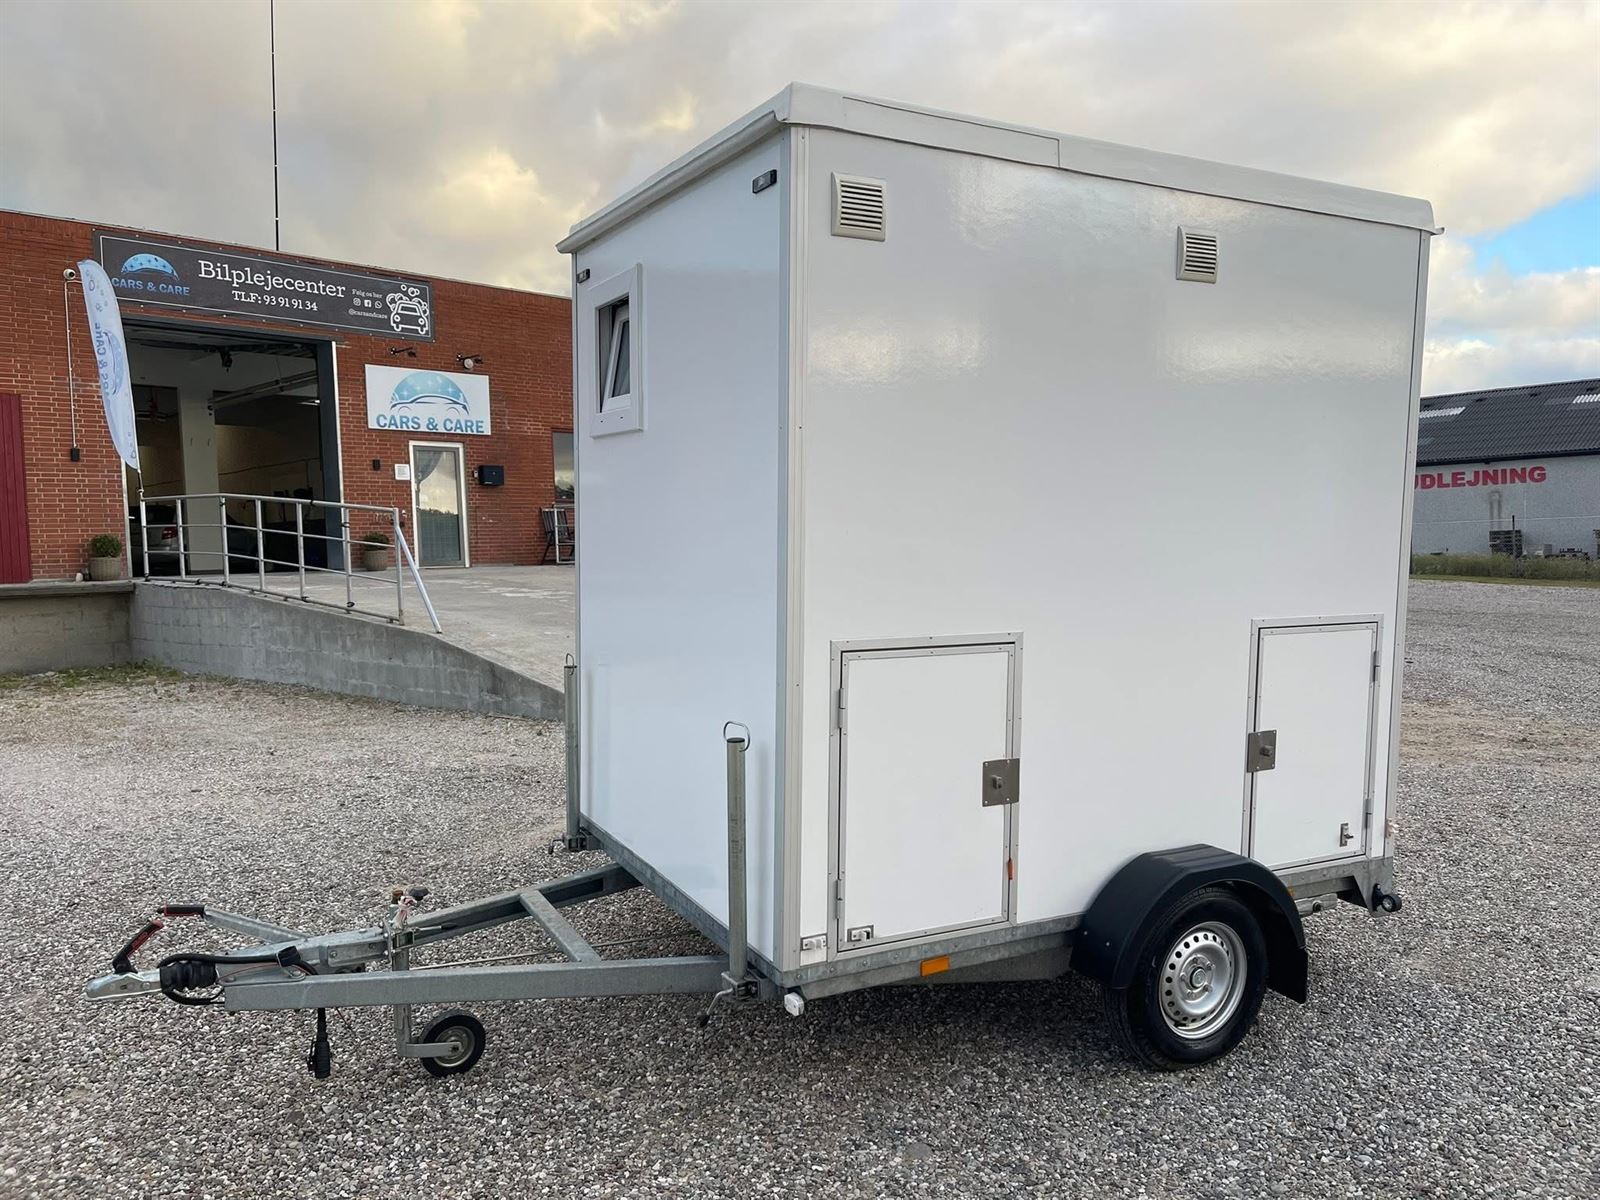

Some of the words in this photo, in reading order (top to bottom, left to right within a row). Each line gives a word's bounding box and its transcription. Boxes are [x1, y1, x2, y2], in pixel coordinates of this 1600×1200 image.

[111, 277, 143, 290] CARS
[147, 282, 157, 292] &
[159, 283, 191, 296] CARE
[198, 260, 346, 298] Bilplejecenter
[232, 290, 262, 304] TLF:
[305, 301, 318, 312] 34
[376, 414, 421, 430] CARS
[426, 416, 439, 431] &
[443, 418, 485, 433] CARE
